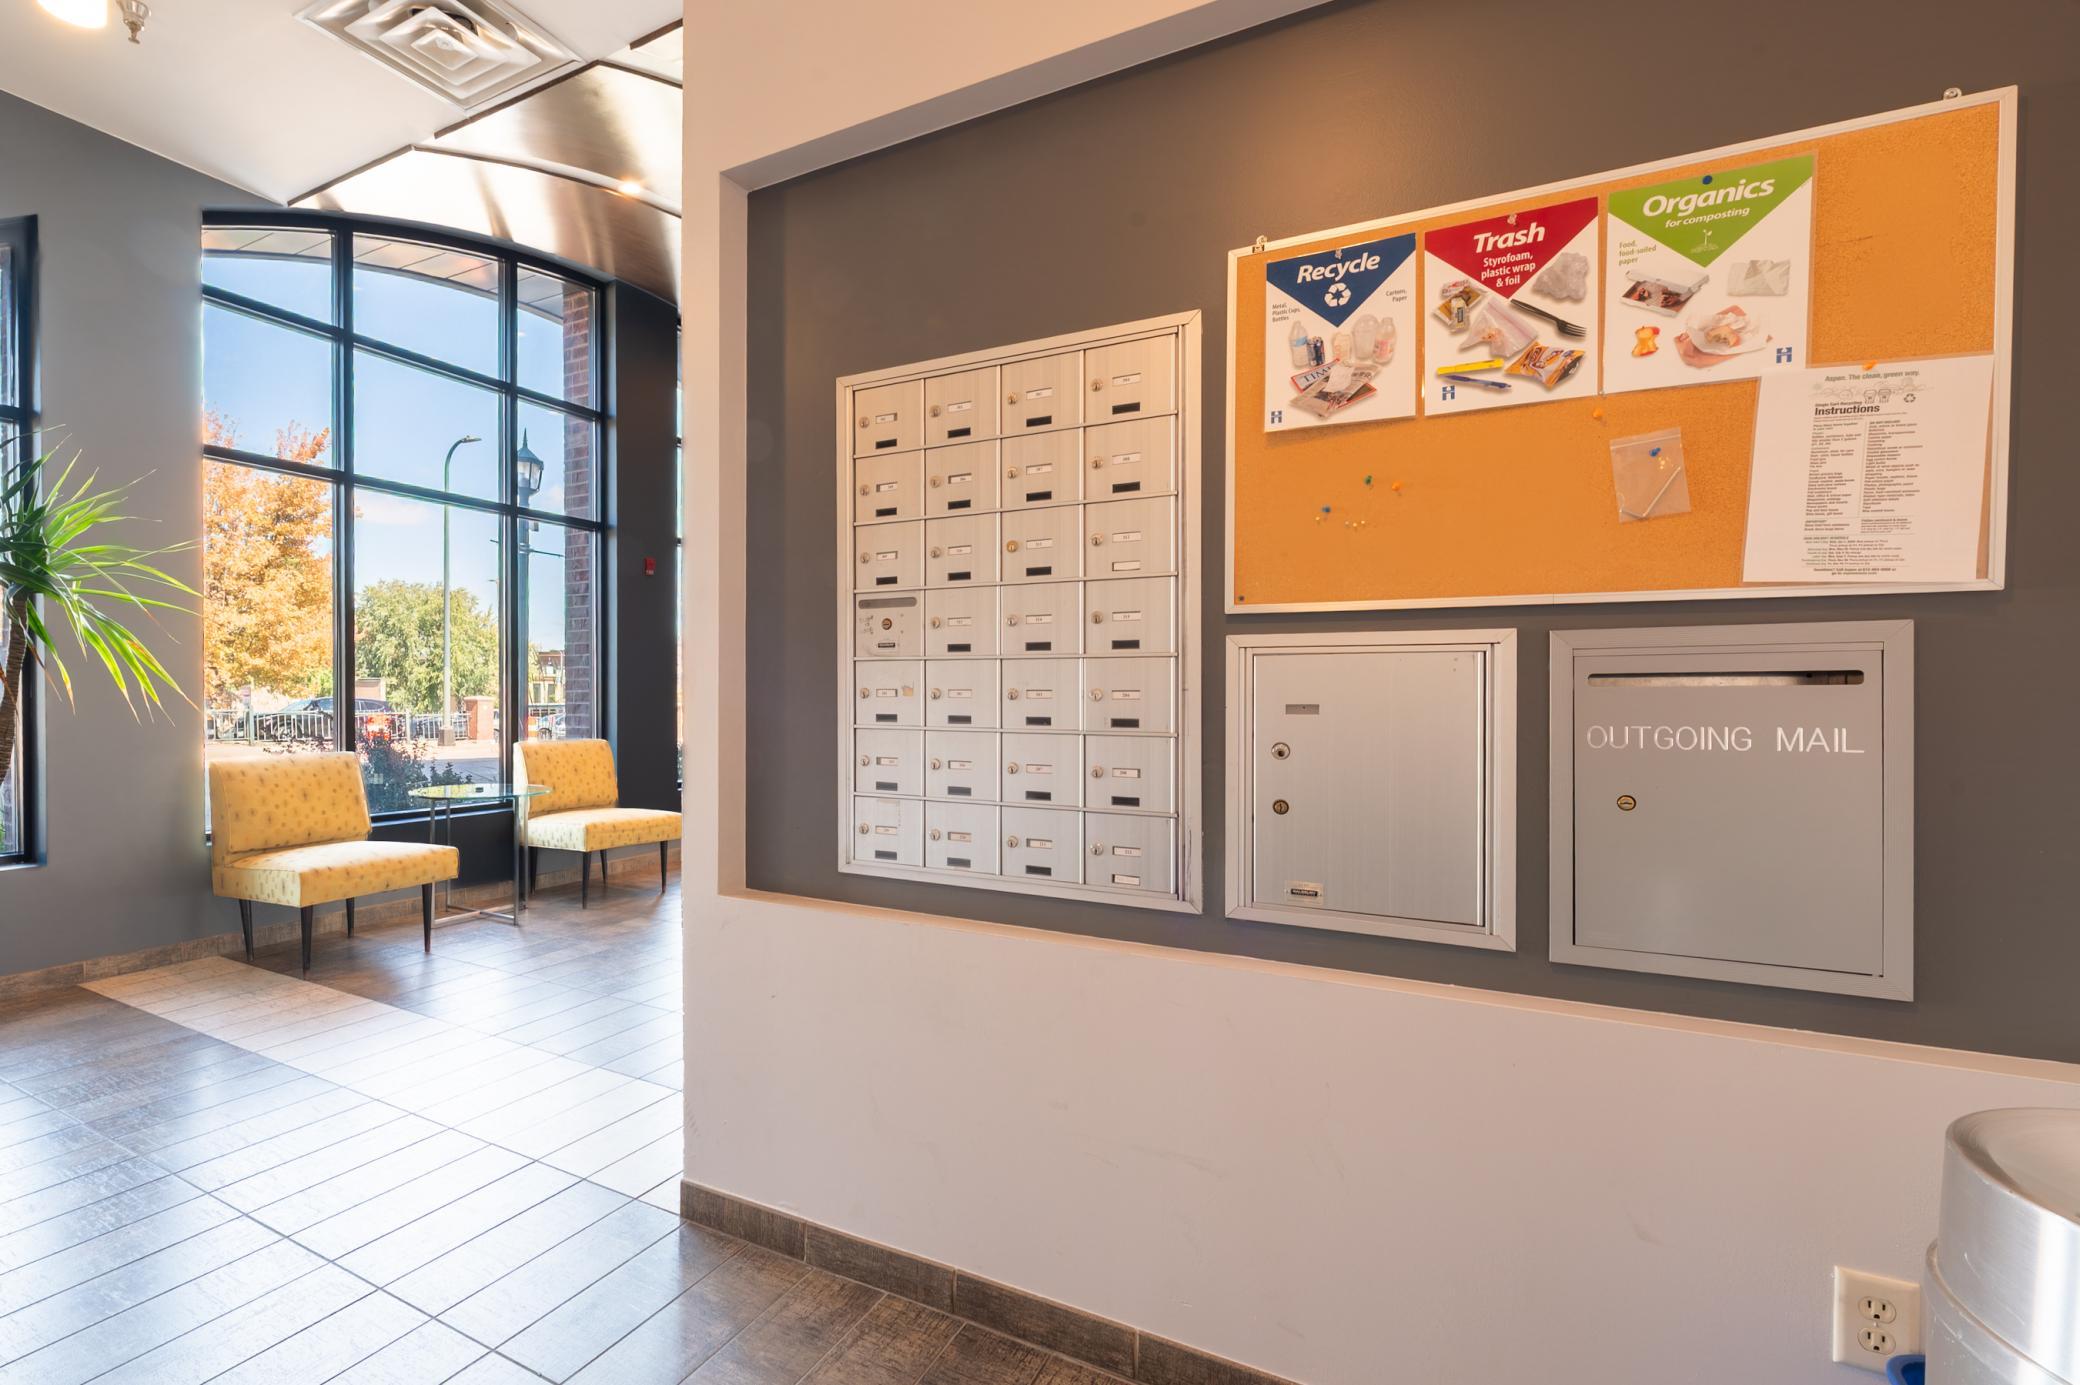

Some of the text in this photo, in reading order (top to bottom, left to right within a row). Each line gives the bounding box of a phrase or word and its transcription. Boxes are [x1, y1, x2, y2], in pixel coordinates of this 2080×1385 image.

[1642, 179, 1776, 217] Organics
[1665, 207, 1750, 228] for composting
[1473, 222, 1546, 253] Trash
[1297, 252, 1380, 284] Recycle
[1483, 252, 1533, 268] Styrofoam,
[1481, 262, 1536, 281] plastic wrap
[1496, 274, 1521, 288] & foil
[1814, 405, 1880, 416] Instructions
[1586, 725, 1865, 753] OUTGOING MAIL
